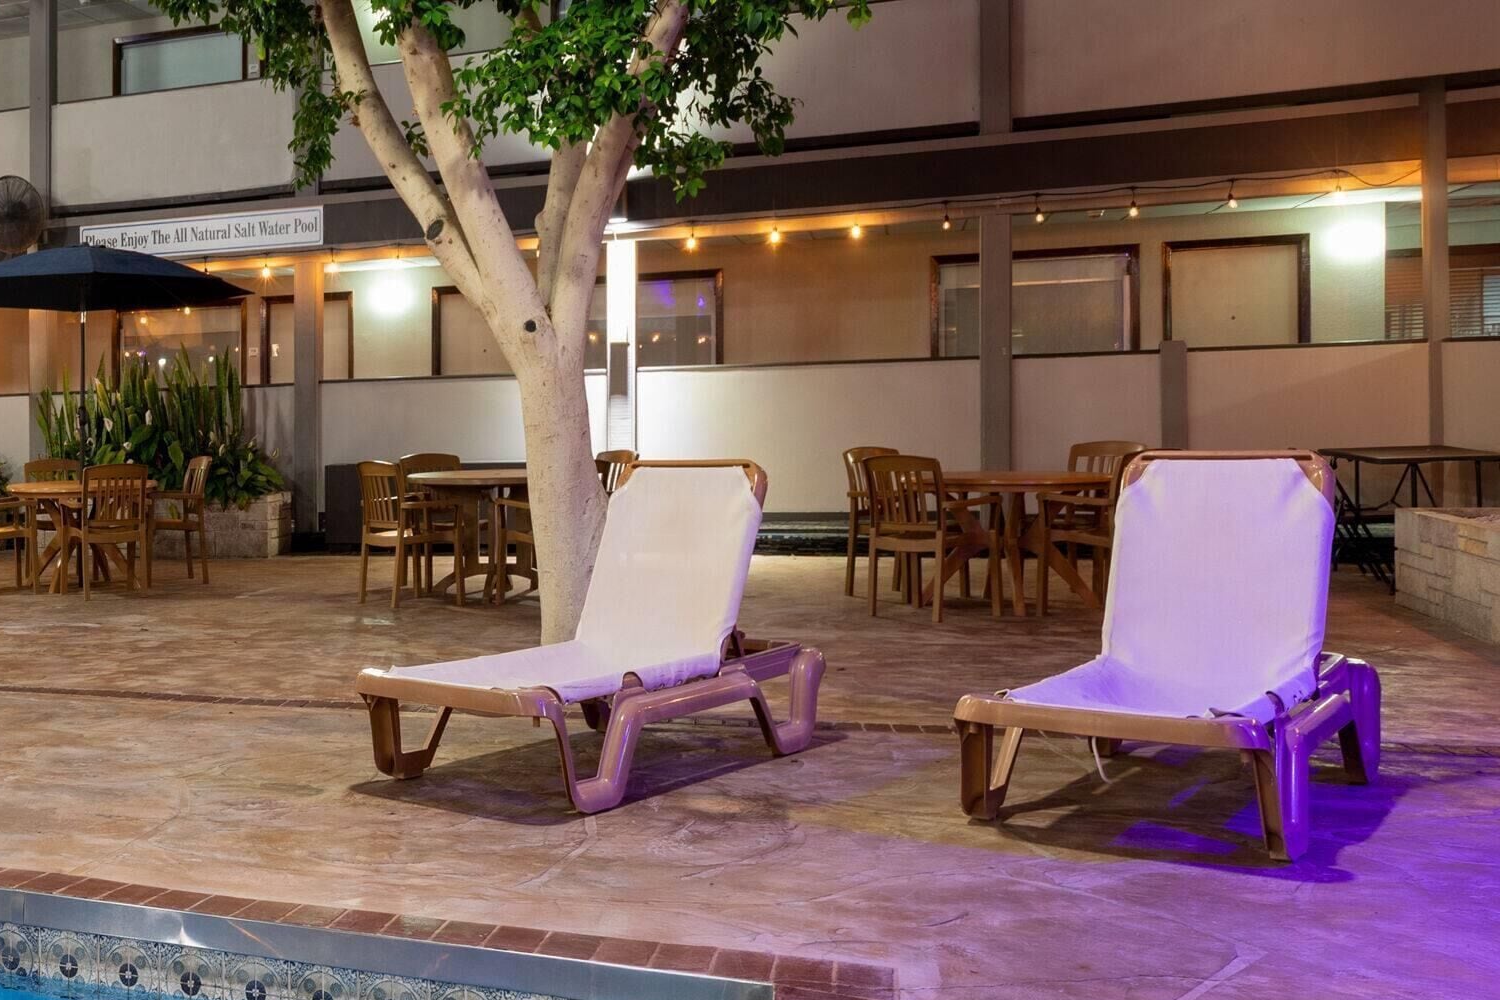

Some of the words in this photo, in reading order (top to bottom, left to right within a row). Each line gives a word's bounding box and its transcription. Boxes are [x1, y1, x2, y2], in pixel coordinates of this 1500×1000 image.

[85, 235, 118, 248] Please
[121, 232, 149, 249] Enjoy
[151, 229, 171, 245] The
[174, 227, 188, 243] All
[191, 223, 231, 242] Natural
[234, 222, 256, 239] Salt
[258, 219, 291, 237] Water
[293, 216, 318, 234] Pool
